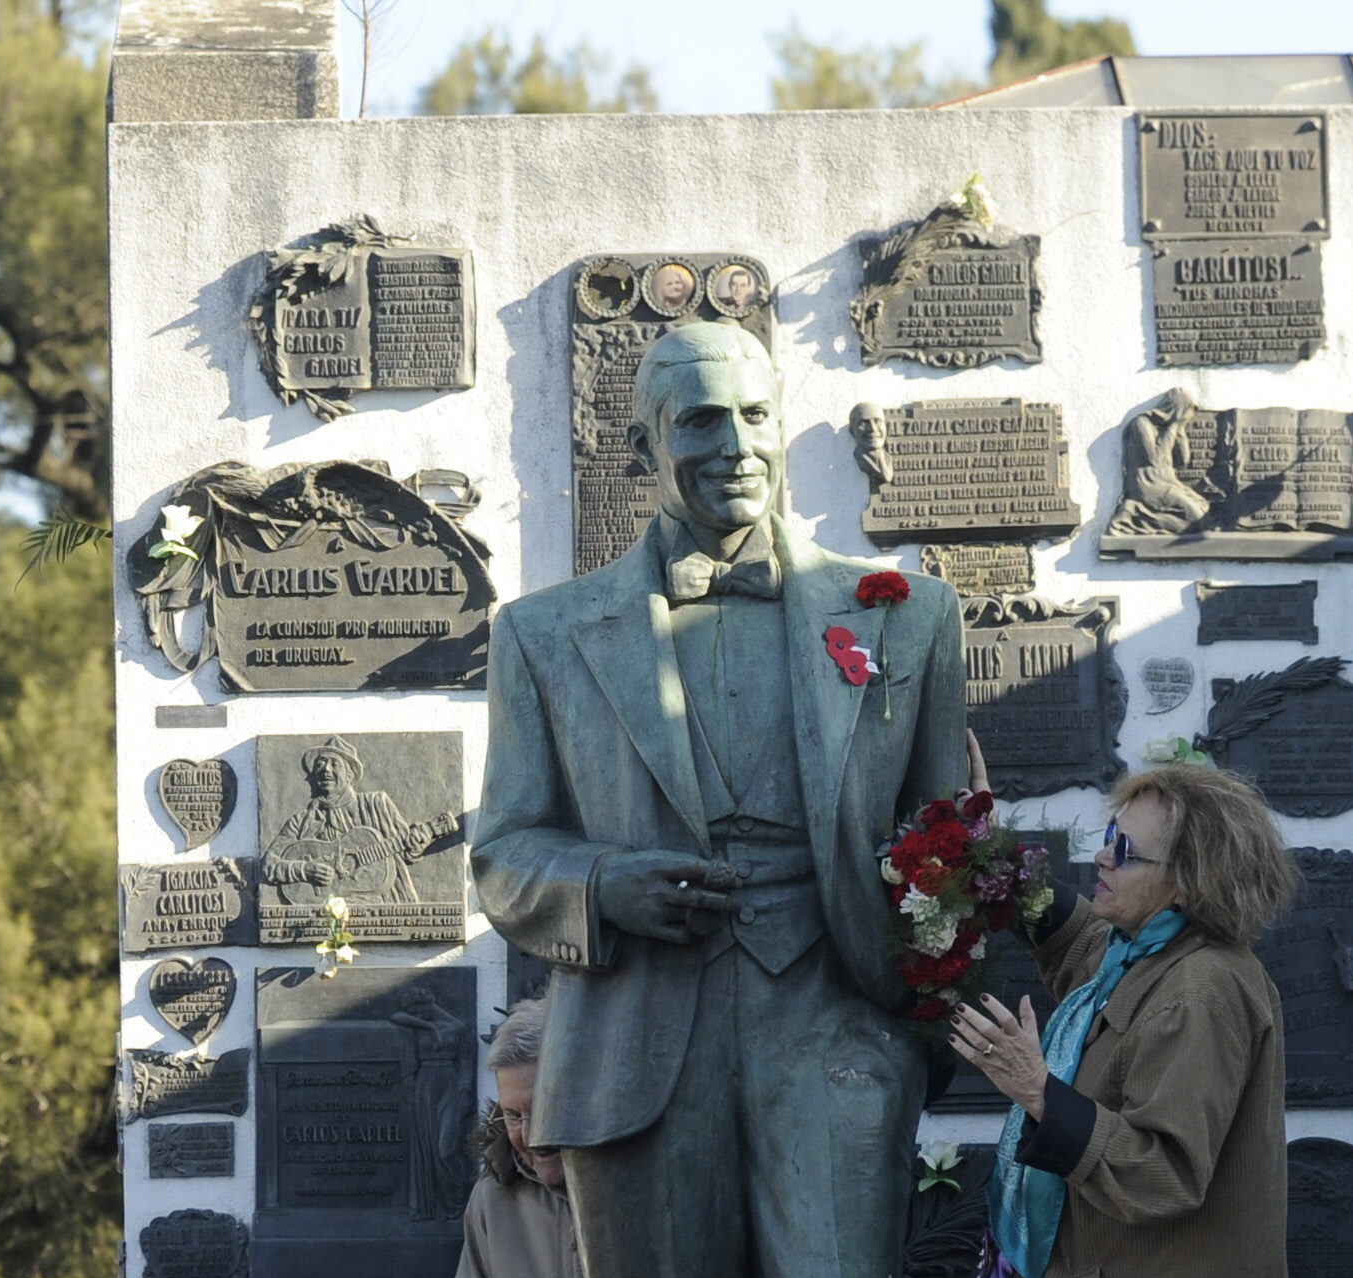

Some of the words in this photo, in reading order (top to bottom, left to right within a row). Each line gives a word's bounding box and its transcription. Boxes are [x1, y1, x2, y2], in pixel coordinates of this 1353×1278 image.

[228, 559, 343, 595] CARLOS
[353, 558, 468, 594] GARDEL
[255, 619, 271, 637] LA
[255, 647, 279, 664] DEL
